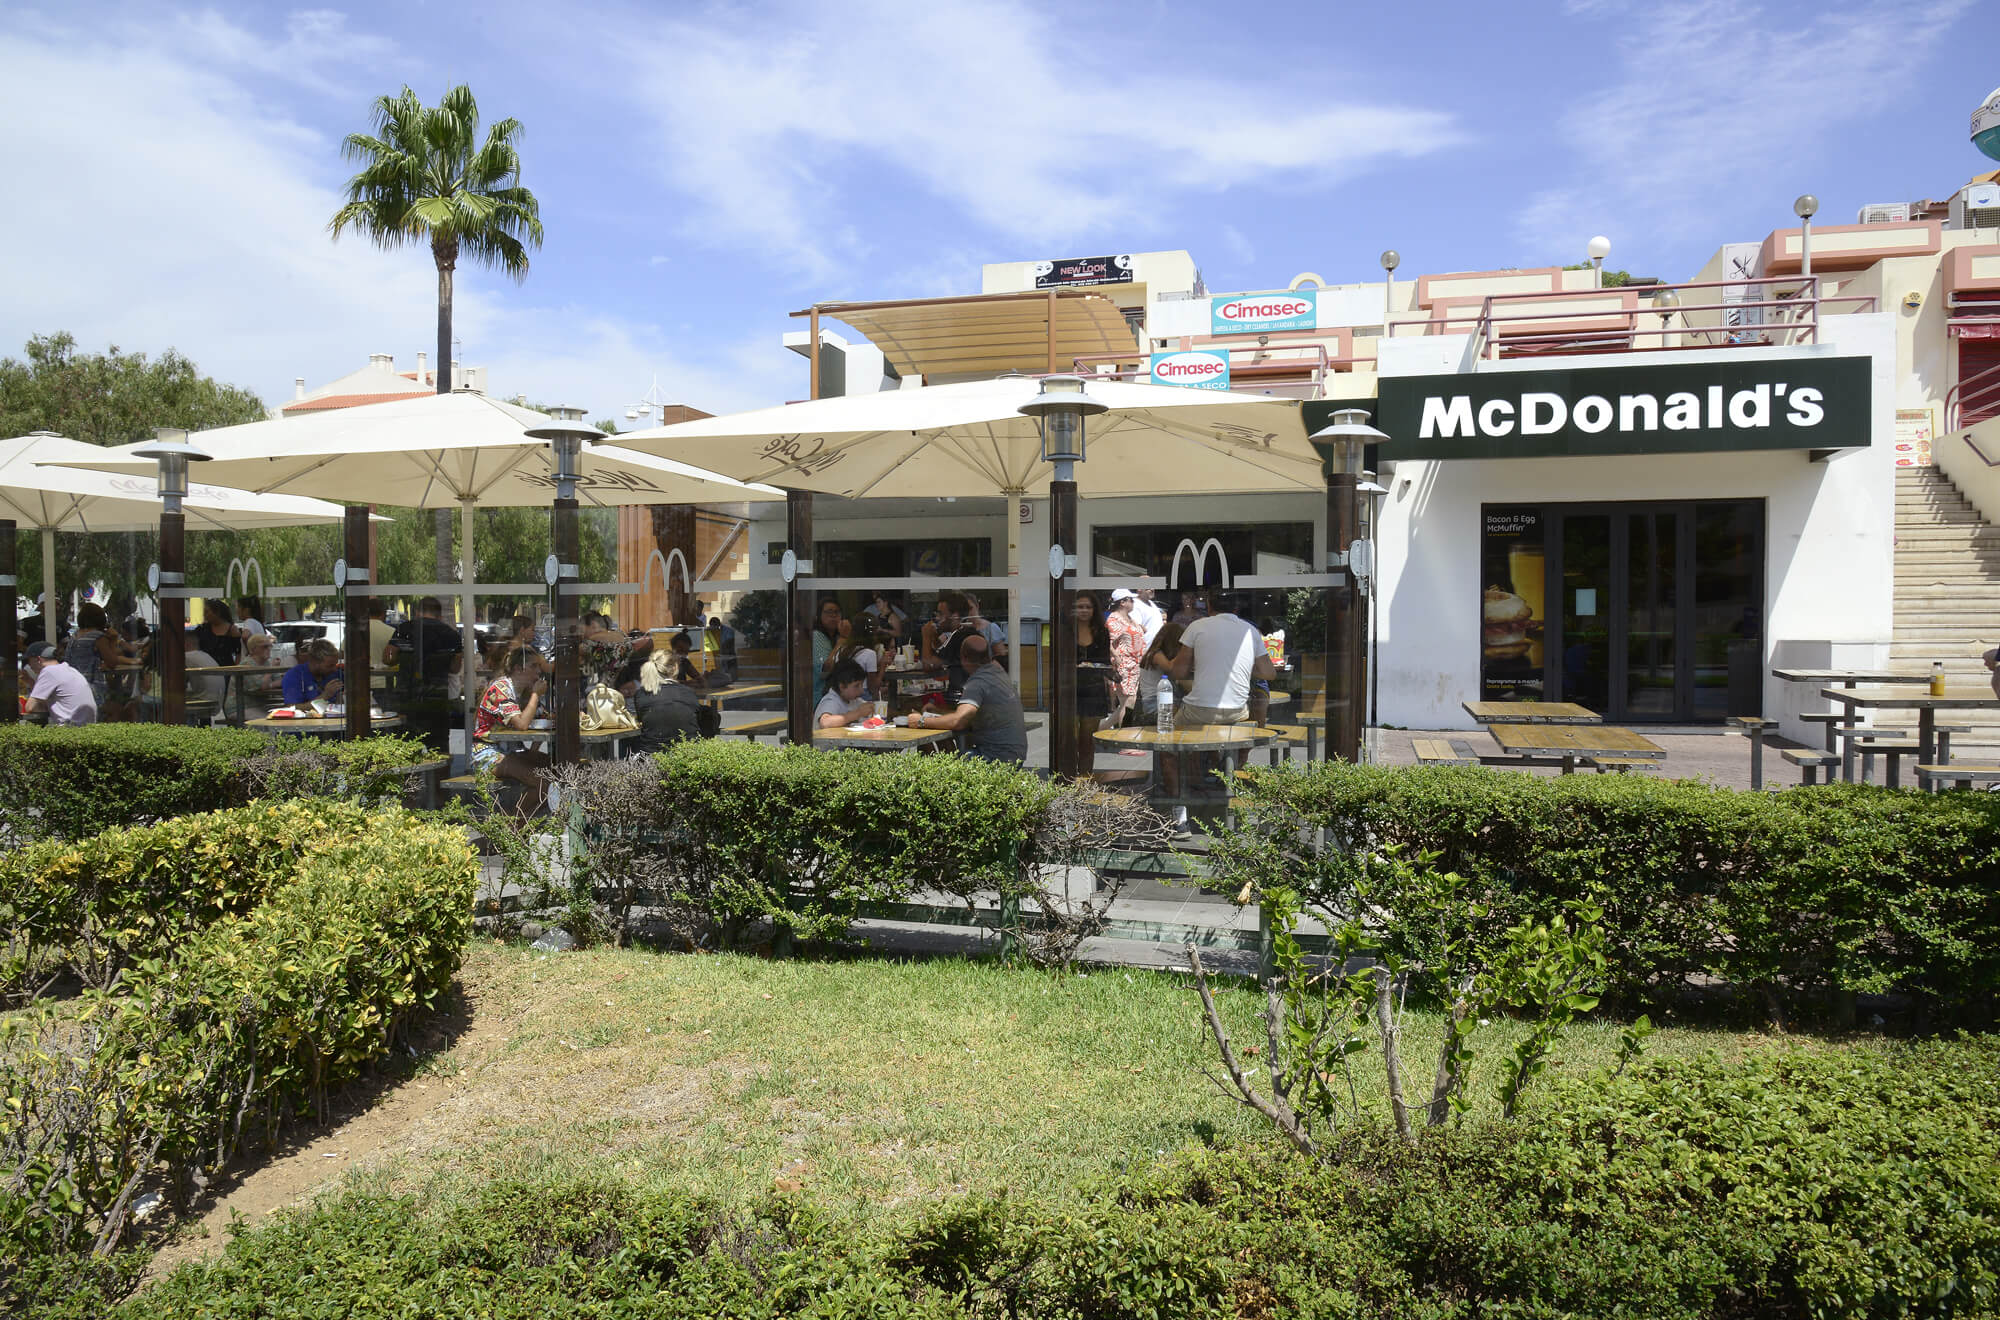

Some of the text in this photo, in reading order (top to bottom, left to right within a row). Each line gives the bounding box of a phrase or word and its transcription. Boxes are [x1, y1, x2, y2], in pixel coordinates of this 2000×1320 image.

[1060, 264, 1107, 275] NEW LOOK
[1222, 302, 1306, 319] Cimasec
[1156, 362, 1224, 377] Cimasec
[1418, 382, 1825, 439] McDonald's
[1520, 515, 1536, 524] Egg
